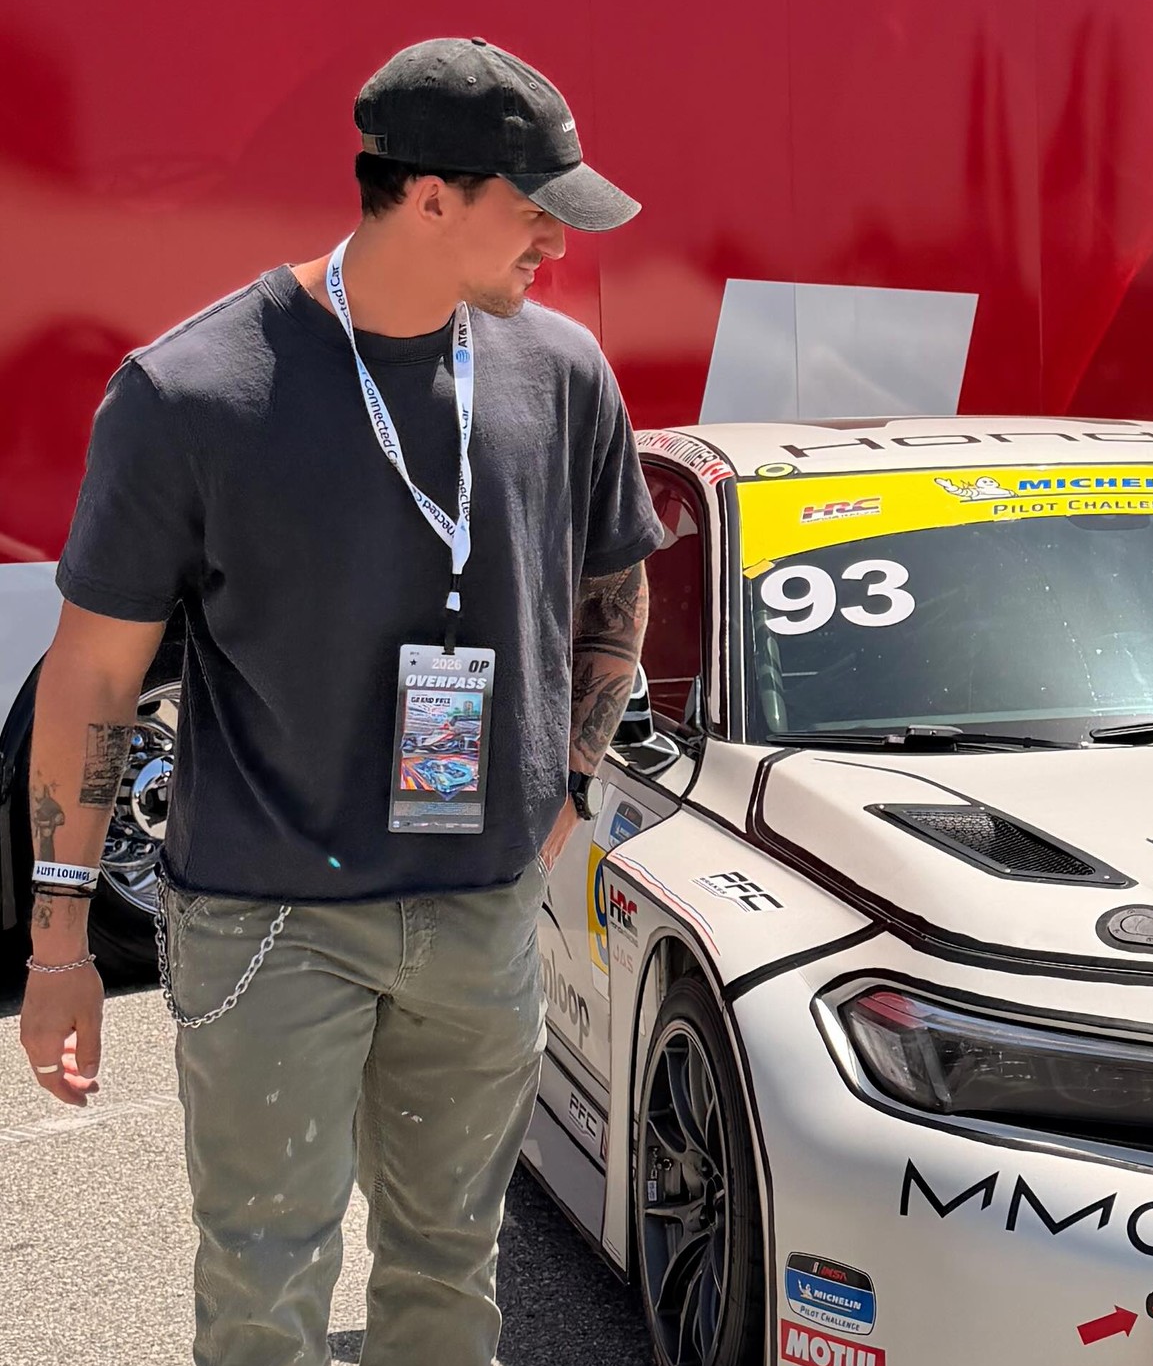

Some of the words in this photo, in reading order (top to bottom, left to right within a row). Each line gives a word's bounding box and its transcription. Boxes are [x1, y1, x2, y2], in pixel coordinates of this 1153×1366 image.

[330, 264, 340, 287] Car
[458, 323, 468, 348] AT&T
[364, 378, 396, 448] Connected
[802, 497, 880, 520] HRC
[994, 502, 1058, 515] PILOT
[760, 559, 916, 636] 93
[432, 658, 463, 671] 2026
[468, 660, 490, 673] OP
[405, 674, 487, 689] OVERPASS
[708, 871, 784, 911] PFC
[542, 949, 590, 1049] nloop
[569, 1092, 597, 1137] PFC
[813, 1289, 862, 1310] MICHELIN
[800, 1305, 819, 1319] PILOT
[821, 1312, 861, 1332] CHALLENGE
